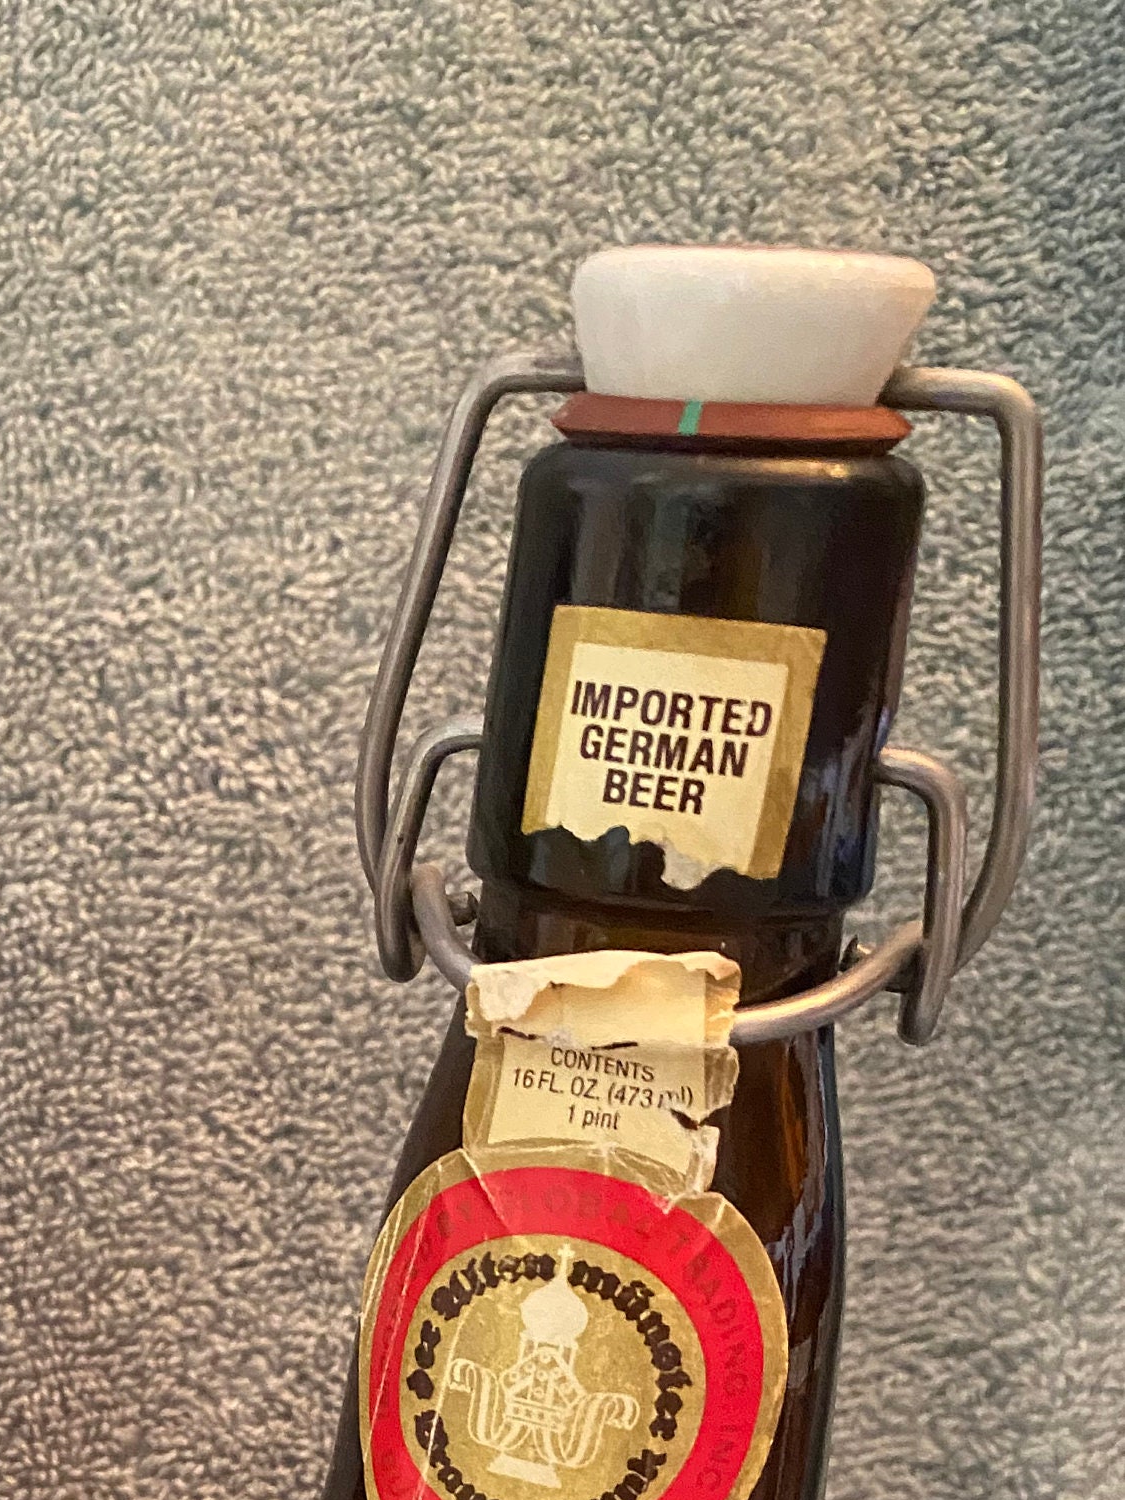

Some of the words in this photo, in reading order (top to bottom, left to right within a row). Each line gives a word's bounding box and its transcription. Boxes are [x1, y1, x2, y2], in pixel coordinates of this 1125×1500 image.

[571, 680, 772, 737] IMPORTED
[580, 723, 749, 778] GERMAN
[602, 768, 706, 815] BEER
[551, 1046, 655, 1083] CONTENTS
[571, 1076, 600, 1101] OZ.
[607, 1081, 653, 1110] (473
[567, 1105, 575, 1123] 1
[581, 1107, 621, 1131] pint
